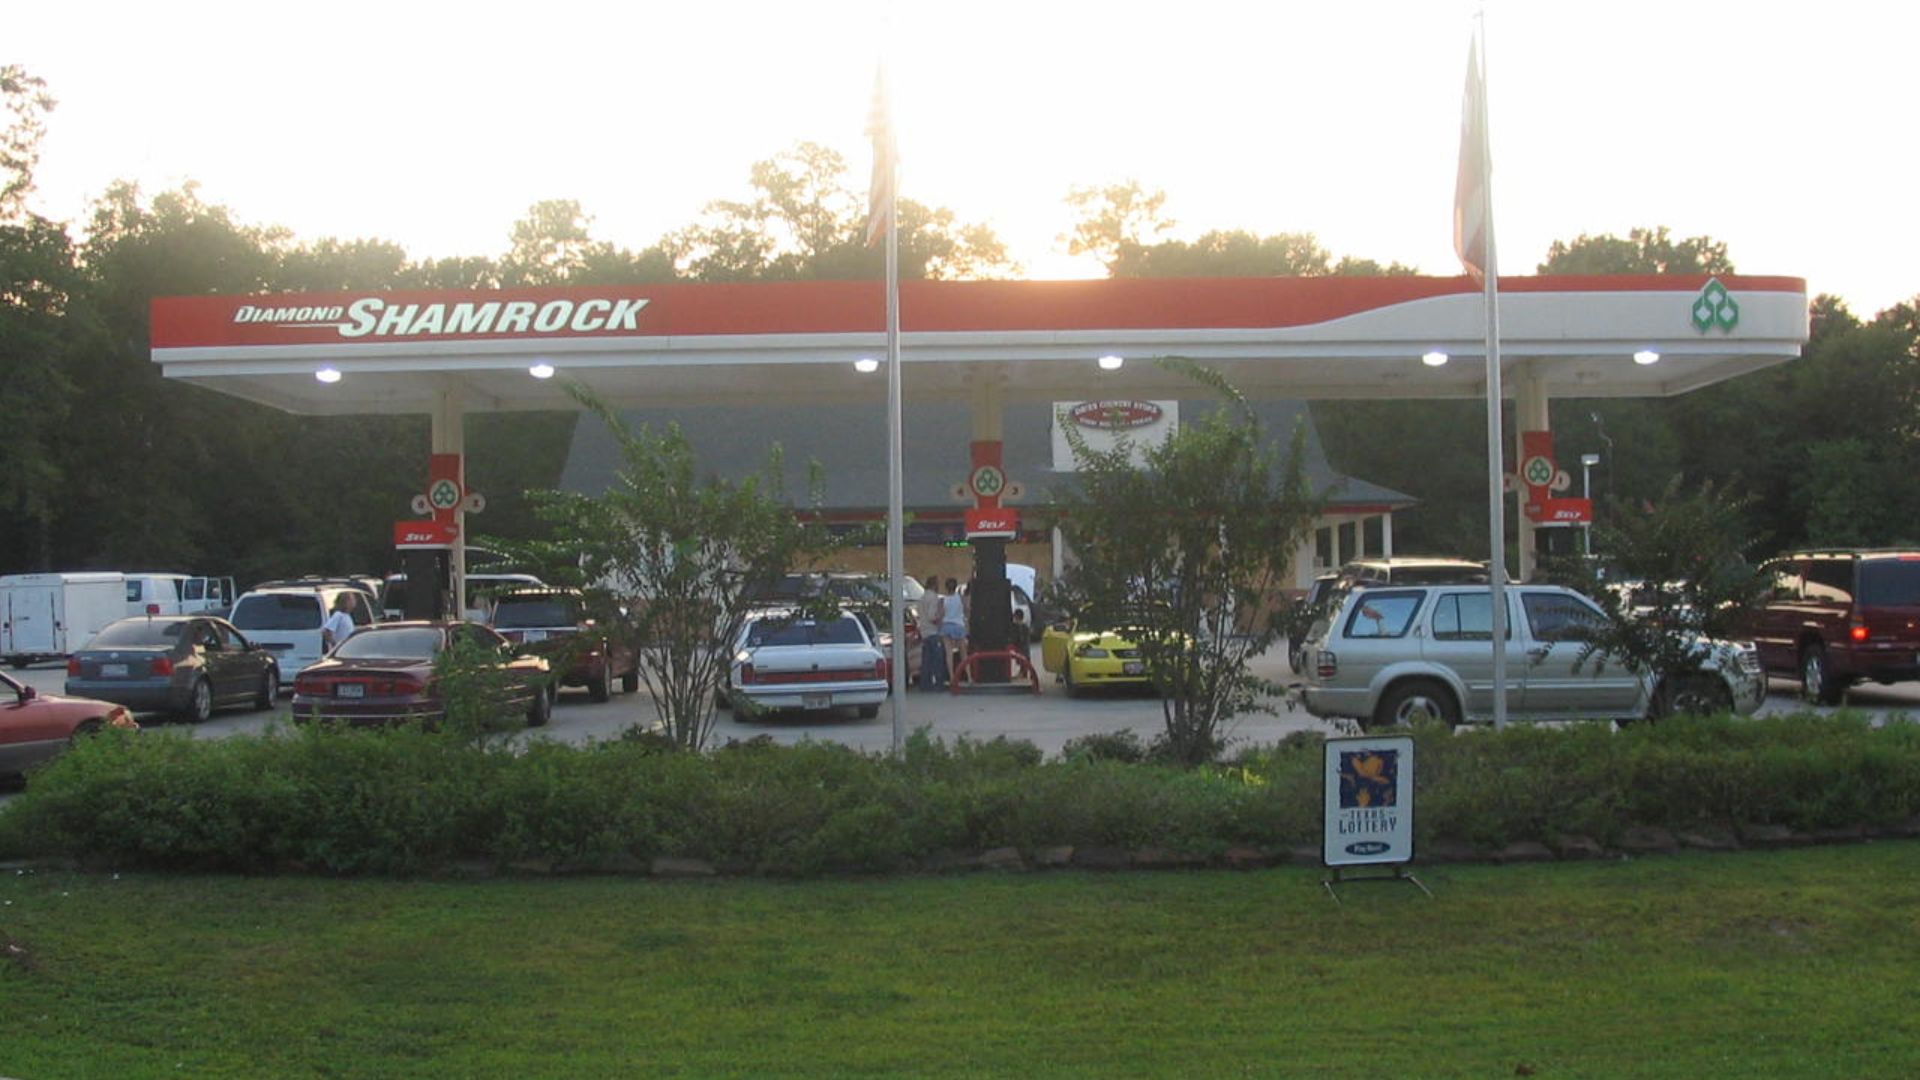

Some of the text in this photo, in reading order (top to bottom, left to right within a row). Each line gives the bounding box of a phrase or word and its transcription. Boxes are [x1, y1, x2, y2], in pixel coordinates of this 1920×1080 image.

[234, 298, 649, 337] DIAMOND SHAMROCK
[977, 520, 1007, 529] SELF
[1350, 809, 1386, 820] TEXAS
[1339, 816, 1397, 833] LOTTERY
